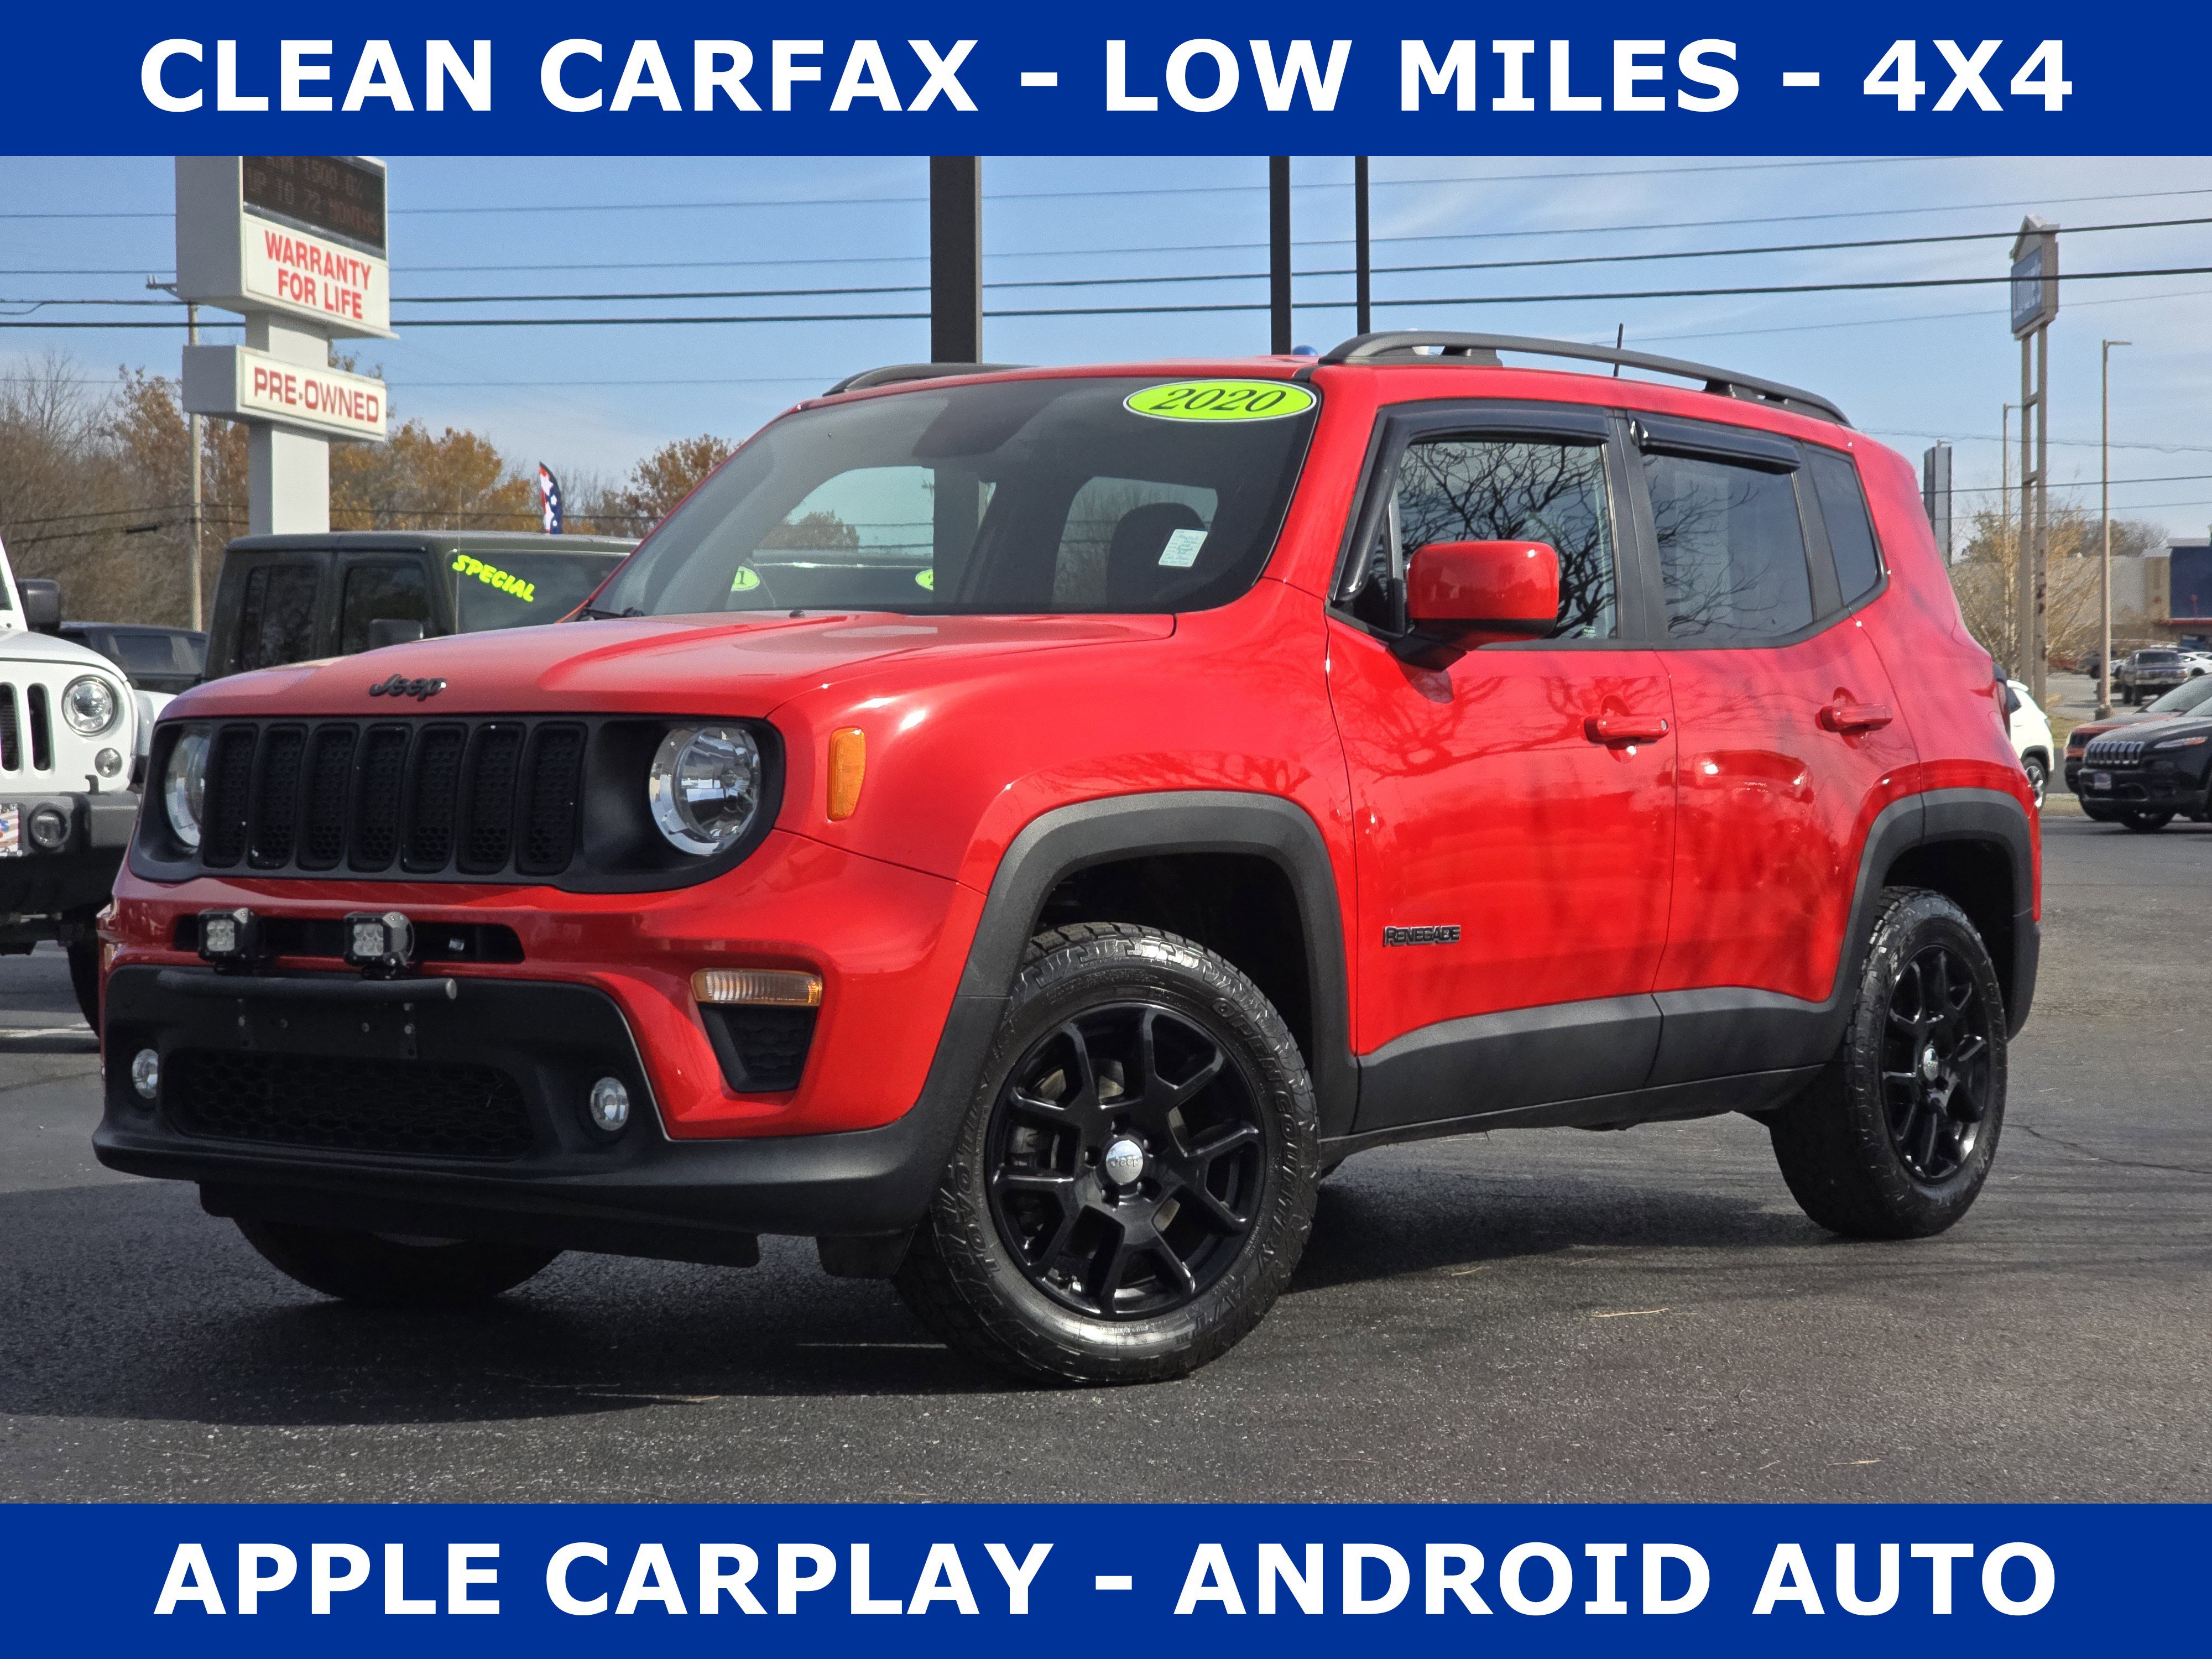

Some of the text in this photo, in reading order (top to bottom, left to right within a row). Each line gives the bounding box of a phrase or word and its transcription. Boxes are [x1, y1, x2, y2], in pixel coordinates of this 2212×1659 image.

[264, 230, 372, 290] WARRANTY
[278, 268, 363, 320] FOR LIFE
[254, 366, 380, 423] PRE-OWNED
[1149, 388, 1287, 413] 2020
[452, 555, 535, 602] SPECIAL
[369, 674, 446, 701] Jeep
[1384, 925, 1460, 946] RENEGADE
